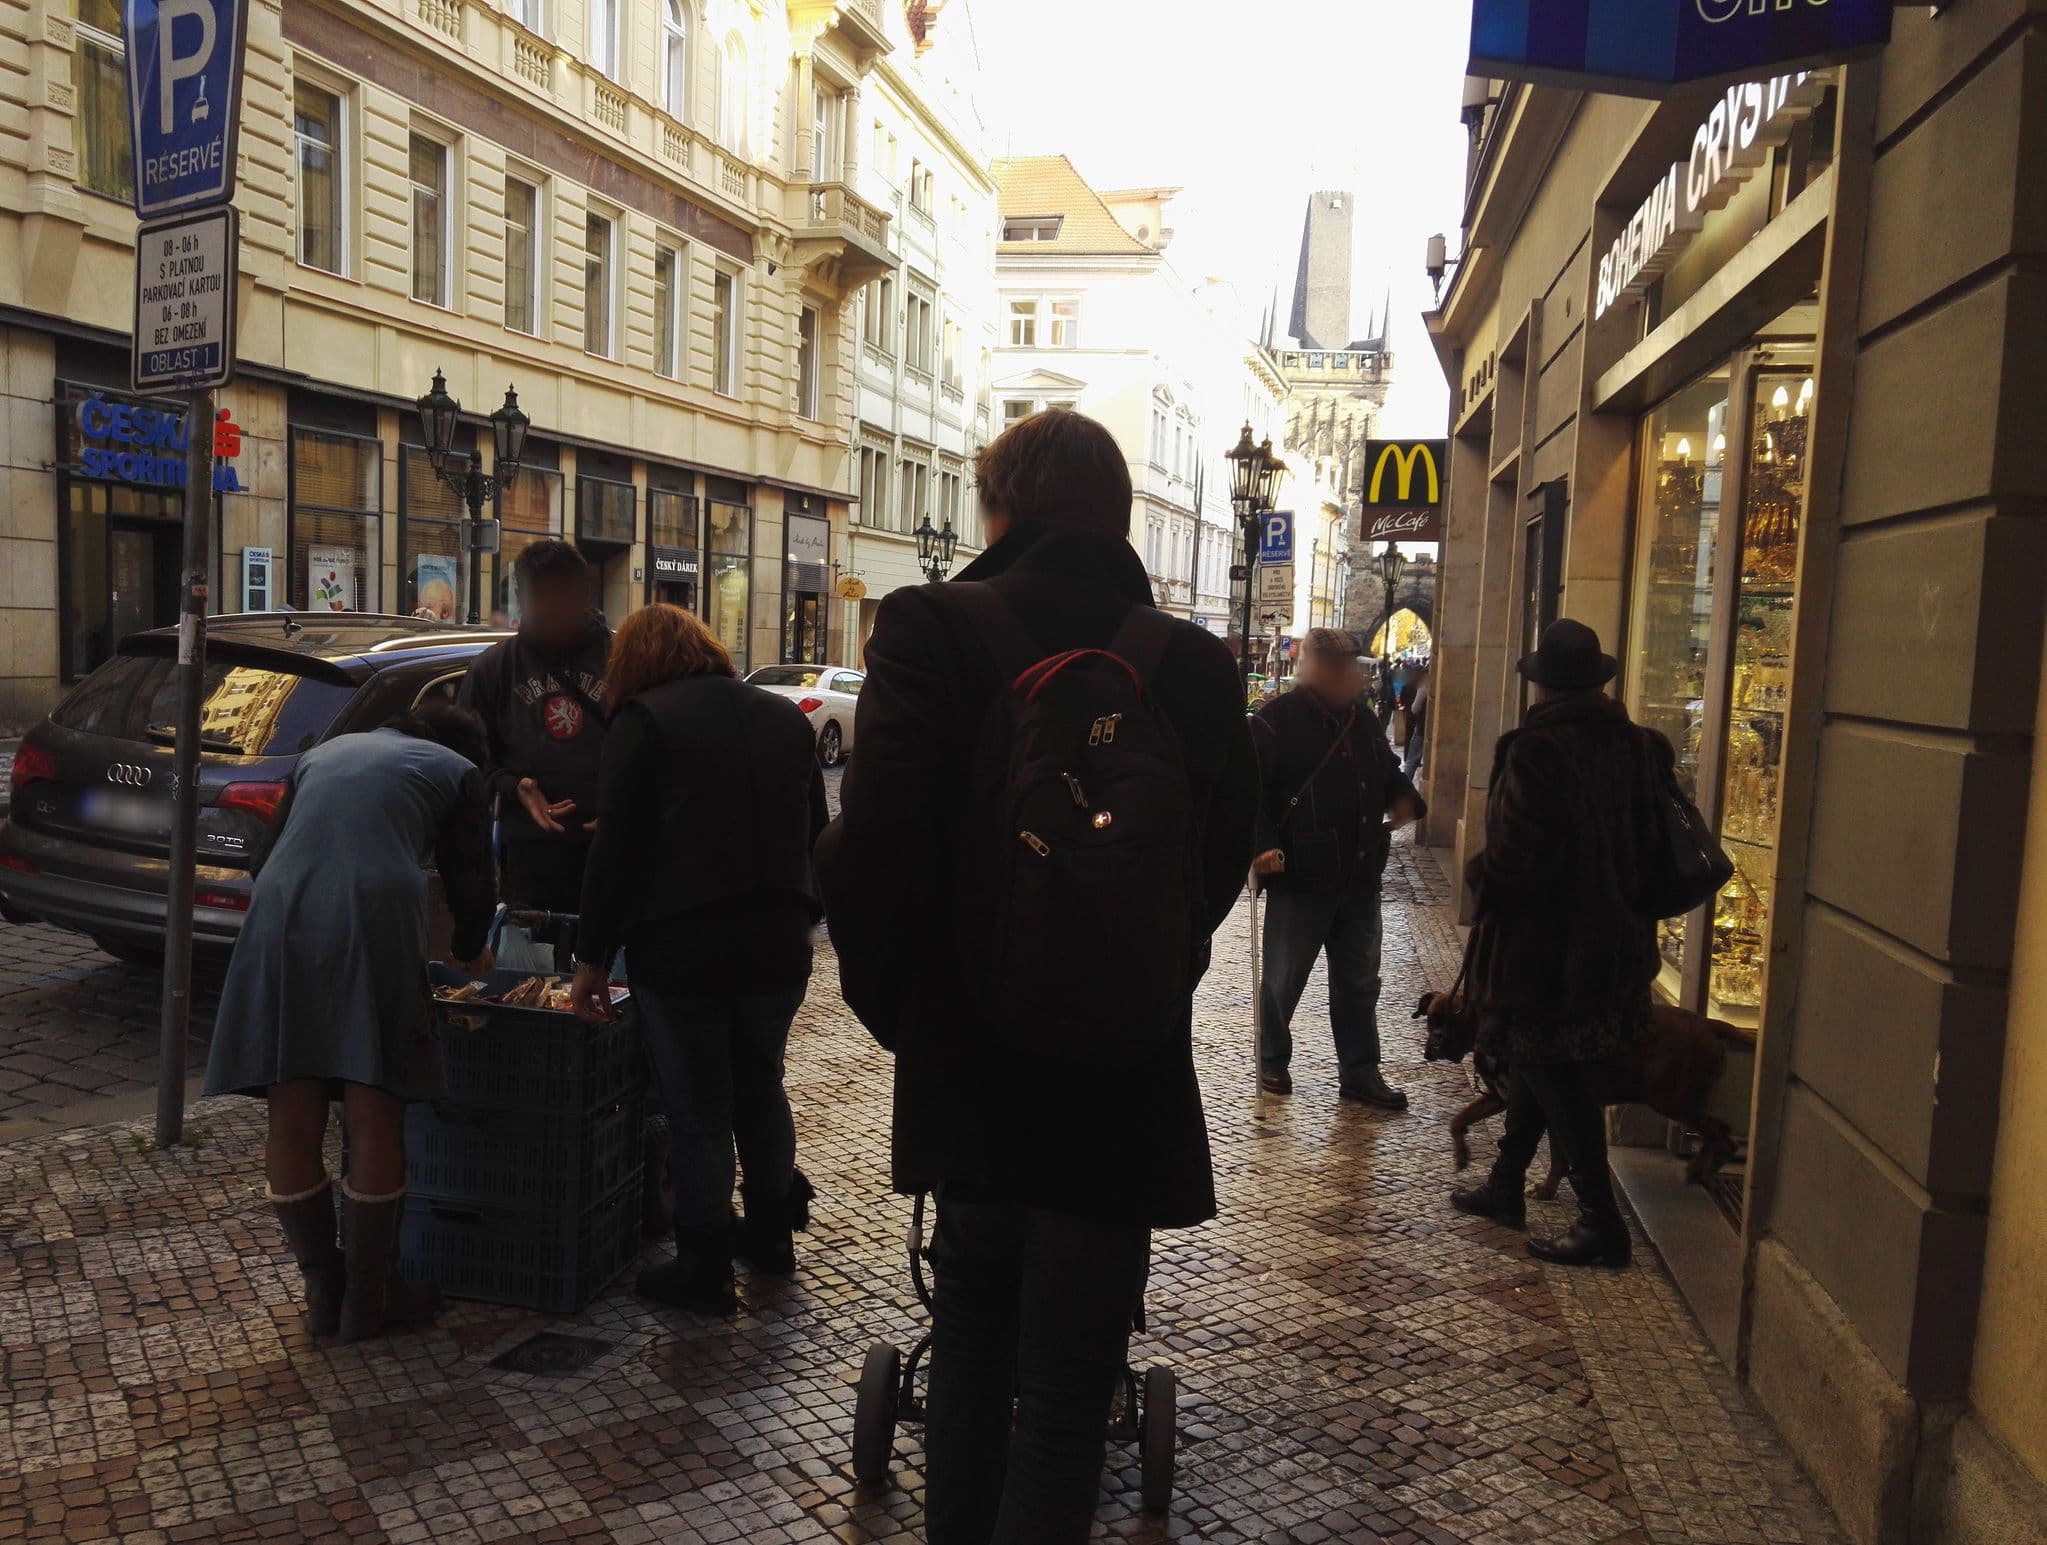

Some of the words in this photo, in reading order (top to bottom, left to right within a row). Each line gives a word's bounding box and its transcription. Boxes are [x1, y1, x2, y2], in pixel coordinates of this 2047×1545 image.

[159, 0, 217, 134] P
[146, 135, 221, 185] RÉSERVÉ
[1595, 161, 1678, 321] BOHEMIA
[1687, 71, 1812, 212] CRYS
[163, 239, 174, 257] 08
[182, 236, 191, 253] 06
[193, 234, 199, 251] h
[160, 263, 166, 280] S
[169, 255, 205, 278] PLATNOU
[142, 279, 185, 304] PARKOVACÍ
[189, 274, 221, 296] KARTOU
[162, 306, 172, 322] 06
[180, 302, 190, 319] 08
[192, 304, 198, 317] h
[154, 329, 169, 345] BEZ
[173, 319, 207, 342] OMEZENÍ
[151, 350, 198, 373] OBLAST
[203, 347, 209, 366] 1
[80, 447, 241, 492] SPOŘITA
[1266, 517, 1287, 547] P
[1371, 511, 1430, 536] McCafé
[656, 557, 676, 571] ČESKÝ
[677, 560, 698, 573] DÁREK
